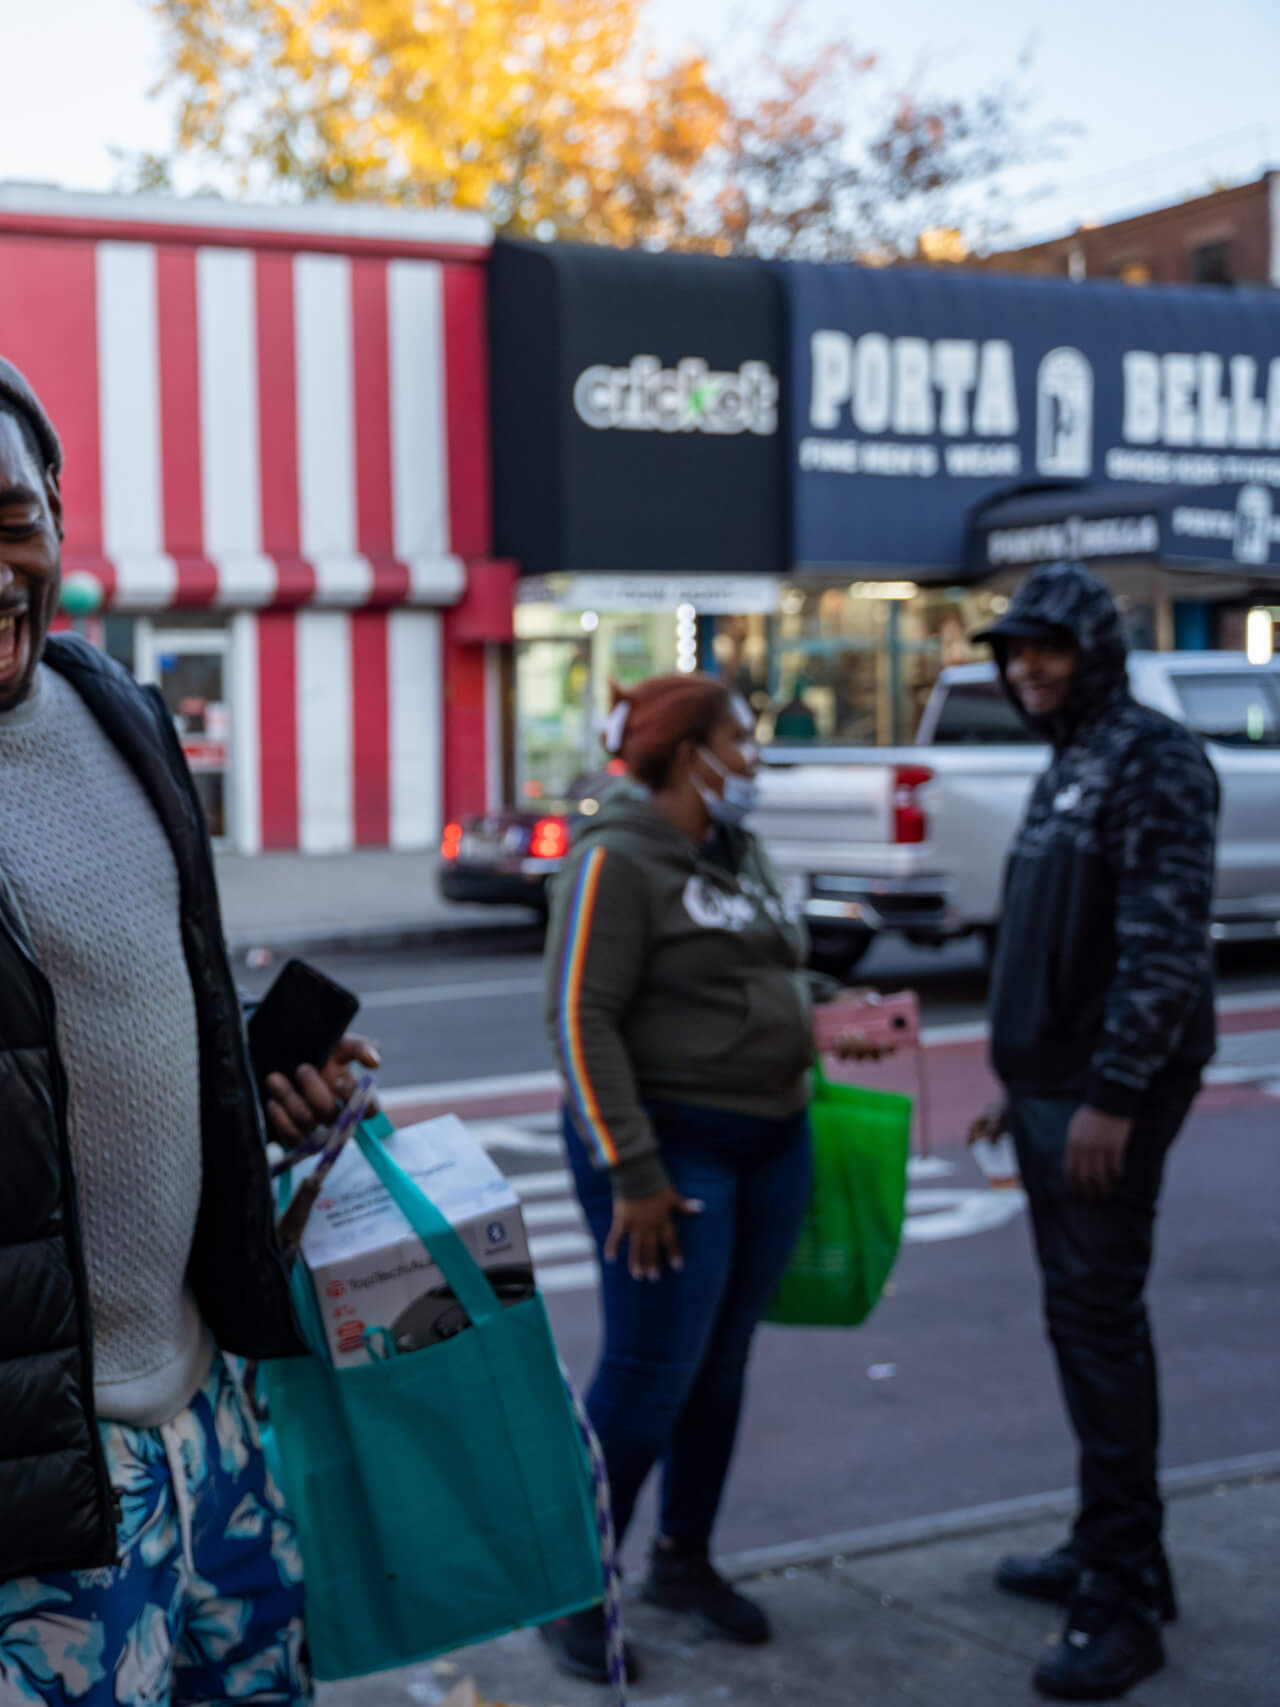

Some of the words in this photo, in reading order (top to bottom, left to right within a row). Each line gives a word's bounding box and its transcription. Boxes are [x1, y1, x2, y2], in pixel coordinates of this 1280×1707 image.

[574, 355, 778, 434] cricket
[811, 330, 1017, 436] PORTA
[1122, 350, 1280, 449] BELL
